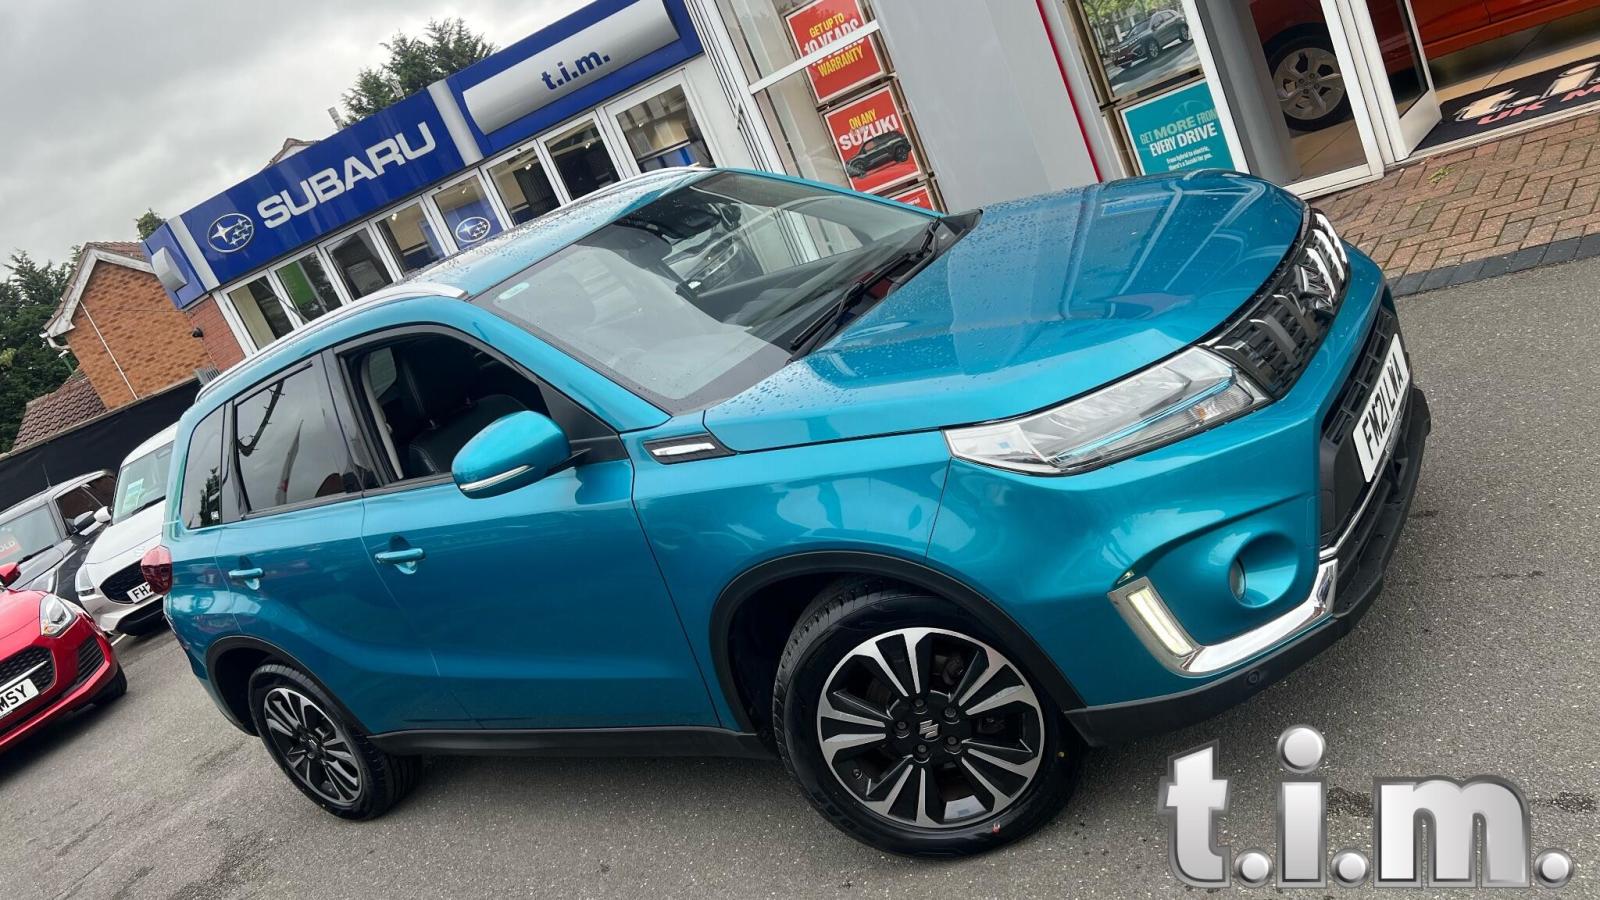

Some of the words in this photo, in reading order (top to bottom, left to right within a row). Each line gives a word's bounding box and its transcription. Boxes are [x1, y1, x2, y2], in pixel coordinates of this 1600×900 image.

[809, 23, 823, 38] GET
[822, 17, 834, 33] UP
[832, 12, 845, 27] TO
[542, 51, 610, 90] t.i.m.
[818, 45, 864, 78] WARRANTY
[849, 115, 862, 130] ON
[860, 108, 877, 126] ANY
[1477, 98, 1549, 125] UK
[839, 113, 899, 151] SUZUKI
[1140, 131, 1153, 145] GET
[1153, 115, 1197, 140] MORE
[1149, 136, 1176, 157] EVERY
[1176, 122, 1218, 147] DRIVE
[257, 121, 436, 229] SUBARU
[131, 583, 149, 599] FH
[0, 684, 27, 712] MSY
